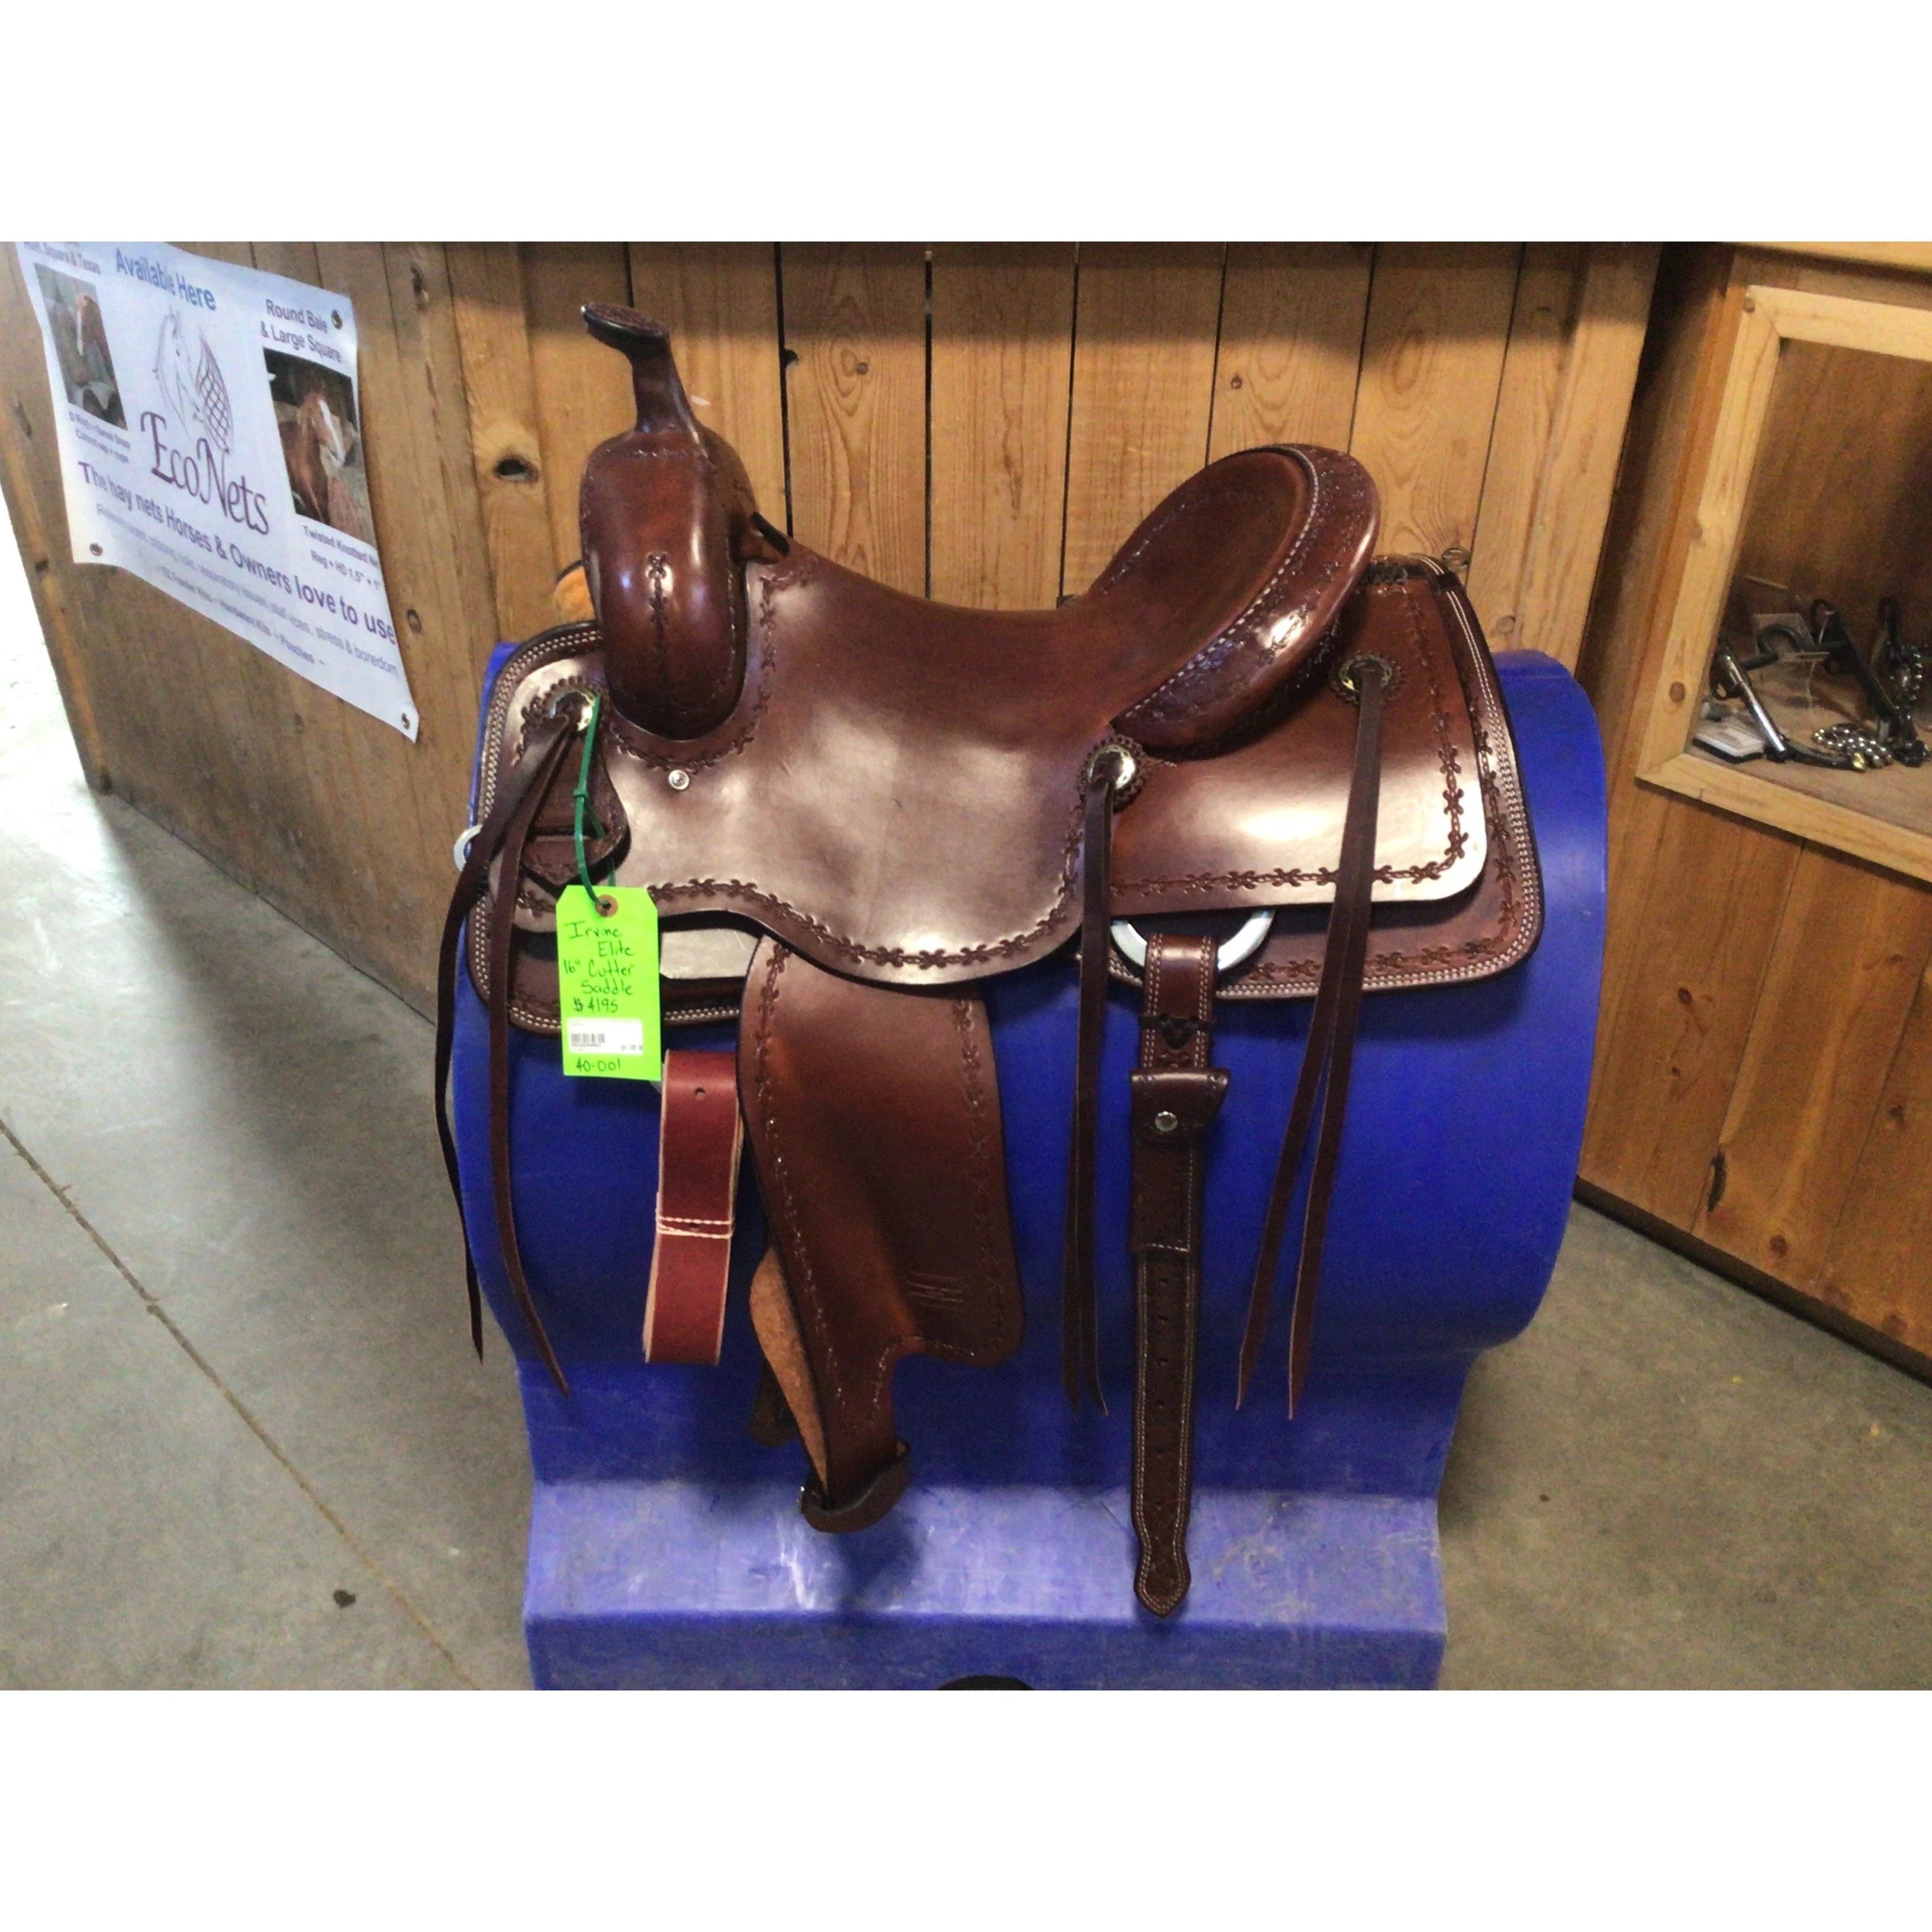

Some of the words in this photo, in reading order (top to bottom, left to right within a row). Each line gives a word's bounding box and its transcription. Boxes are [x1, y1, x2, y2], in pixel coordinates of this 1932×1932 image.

[116, 247, 176, 295] Available
[176, 271, 217, 311] Here
[265, 298, 305, 324] Round
[260, 320, 269, 338] &
[271, 324, 305, 351] Large
[307, 334, 342, 363] Square
[140, 411, 270, 535] EcoNets
[78, 461, 108, 491] The
[107, 475, 133, 511] hay
[135, 494, 164, 524] nets
[165, 505, 212, 552] Horses
[214, 535, 228, 560] &
[229, 543, 292, 594] Owners
[294, 575, 336, 614] love
[339, 595, 359, 625] to
[363, 612, 396, 645] use
[564, 920, 622, 939] Irvine
[598, 939, 636, 958] Elite
[588, 958, 635, 977] Cutter
[581, 977, 633, 996] Saddle
[576, 1057, 621, 1073] 40-001
